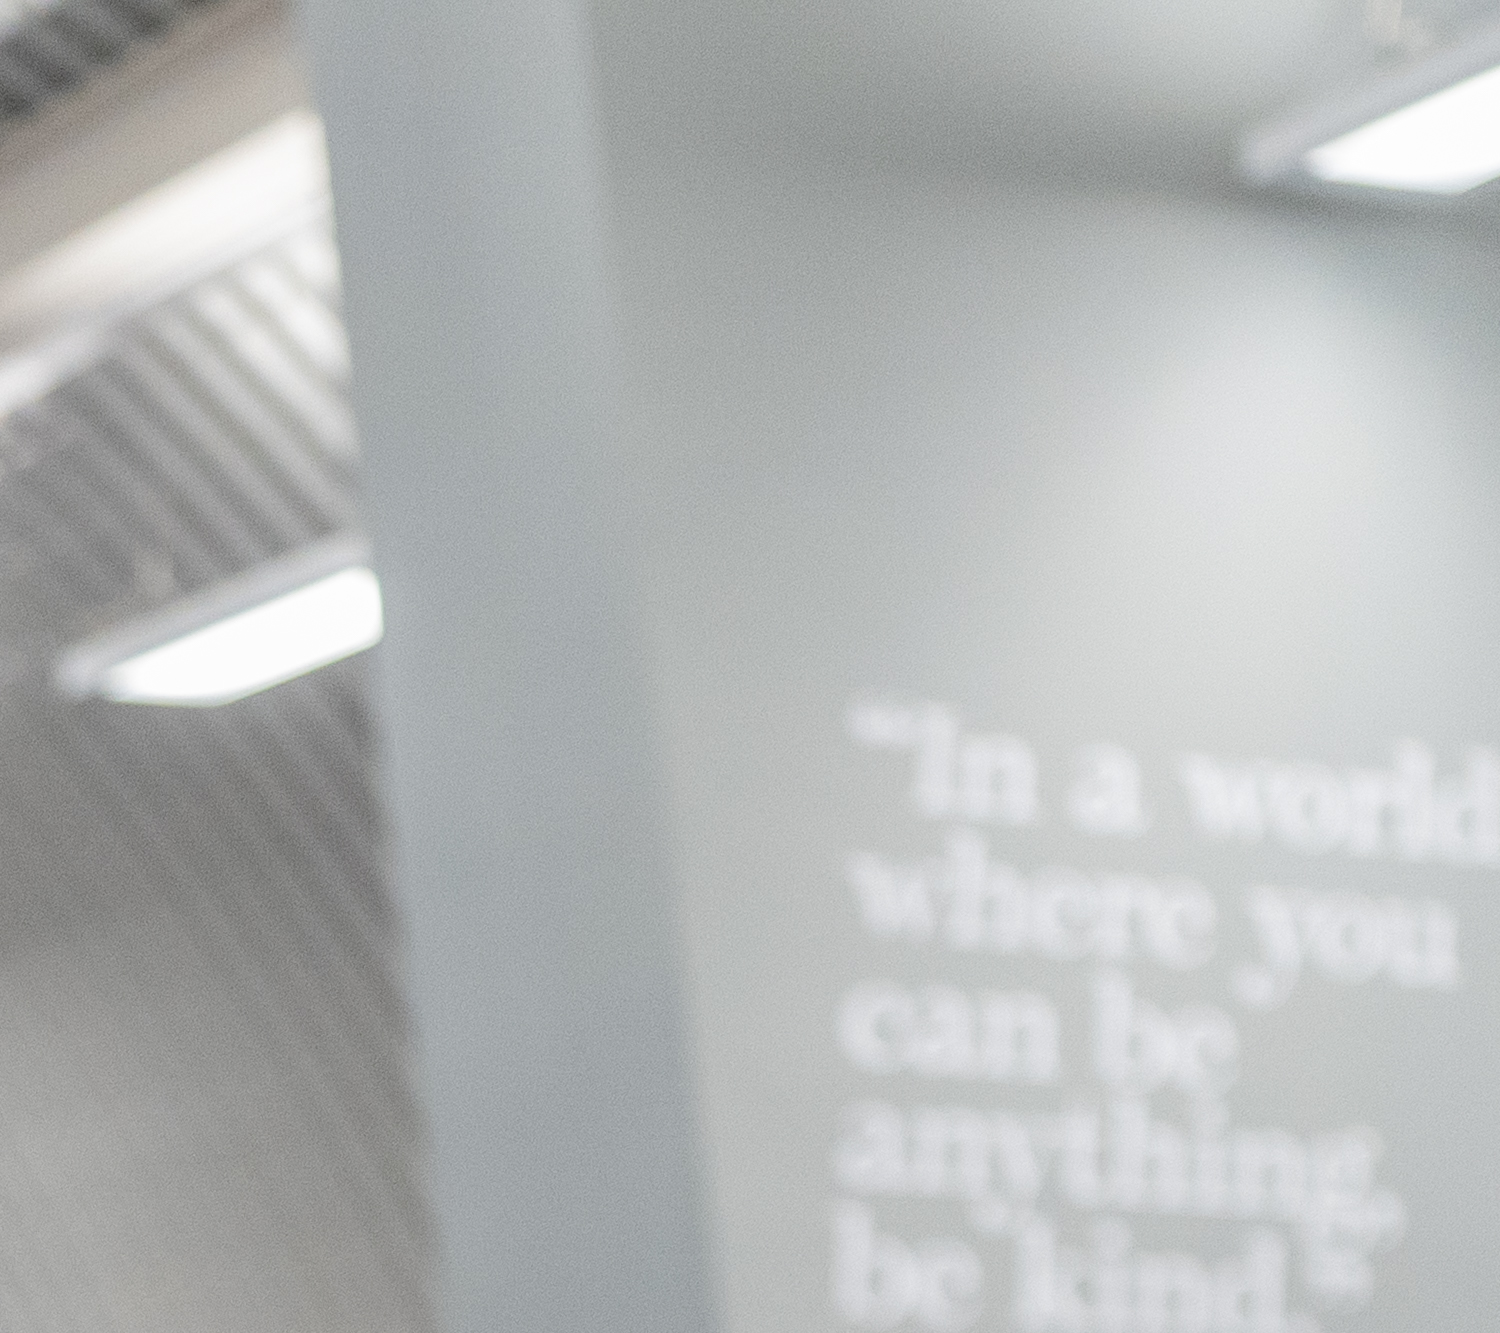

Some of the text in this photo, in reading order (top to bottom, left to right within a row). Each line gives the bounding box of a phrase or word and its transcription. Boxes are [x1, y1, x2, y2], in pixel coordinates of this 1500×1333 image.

[1066, 741, 1150, 837] a
[846, 827, 1463, 1011] where you
[835, 962, 1240, 1096] can be
[832, 1198, 984, 1333] be
